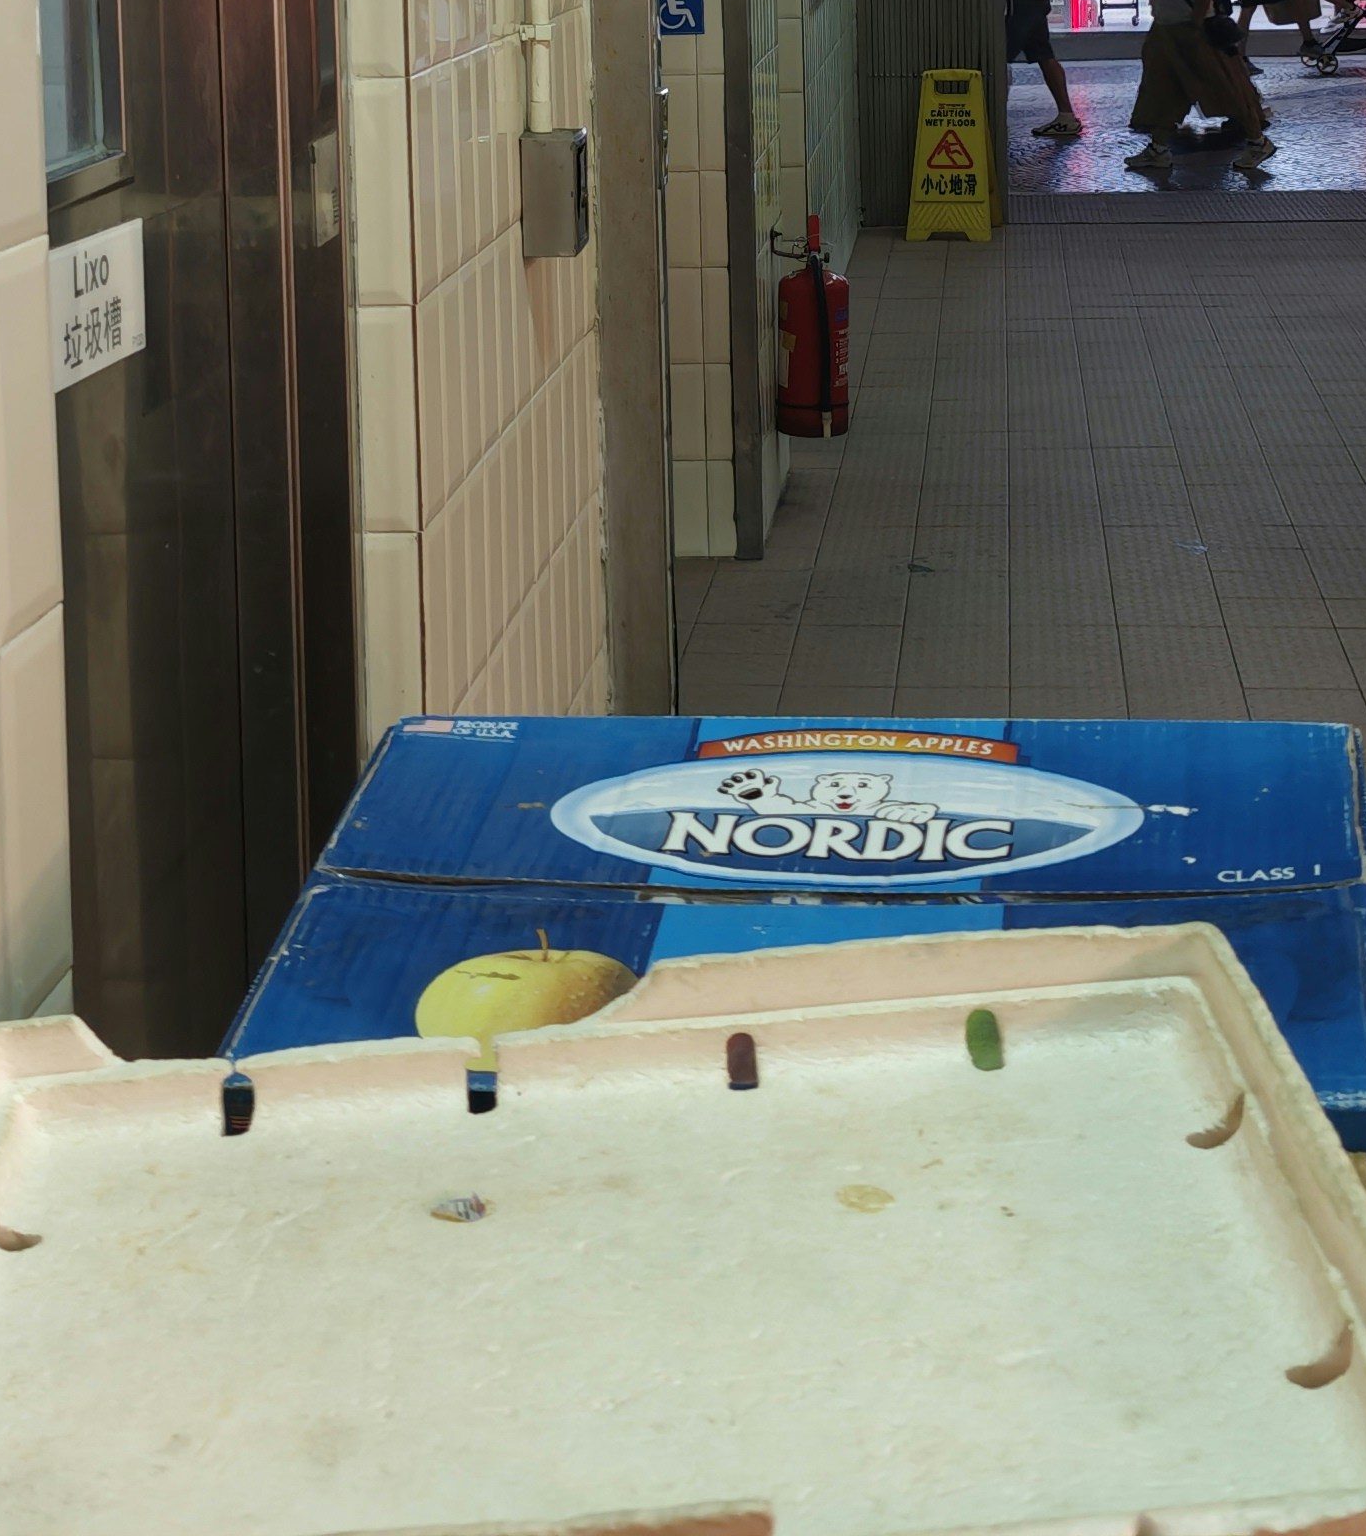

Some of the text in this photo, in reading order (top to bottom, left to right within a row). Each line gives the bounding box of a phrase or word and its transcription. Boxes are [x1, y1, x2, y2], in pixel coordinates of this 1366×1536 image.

[925, 118, 976, 127] WET FLOOR
[930, 109, 971, 118] CAUTION
[921, 173, 978, 196] 小心地滑
[73, 250, 110, 298] Lixo
[64, 296, 122, 369] 垃圾槽
[453, 728, 474, 736] OF
[455, 720, 519, 731] PRODUCE
[722, 733, 994, 756] WASHINGTON APPLES
[660, 810, 1014, 863] NORDIC
[1217, 867, 1296, 883] CLASS
